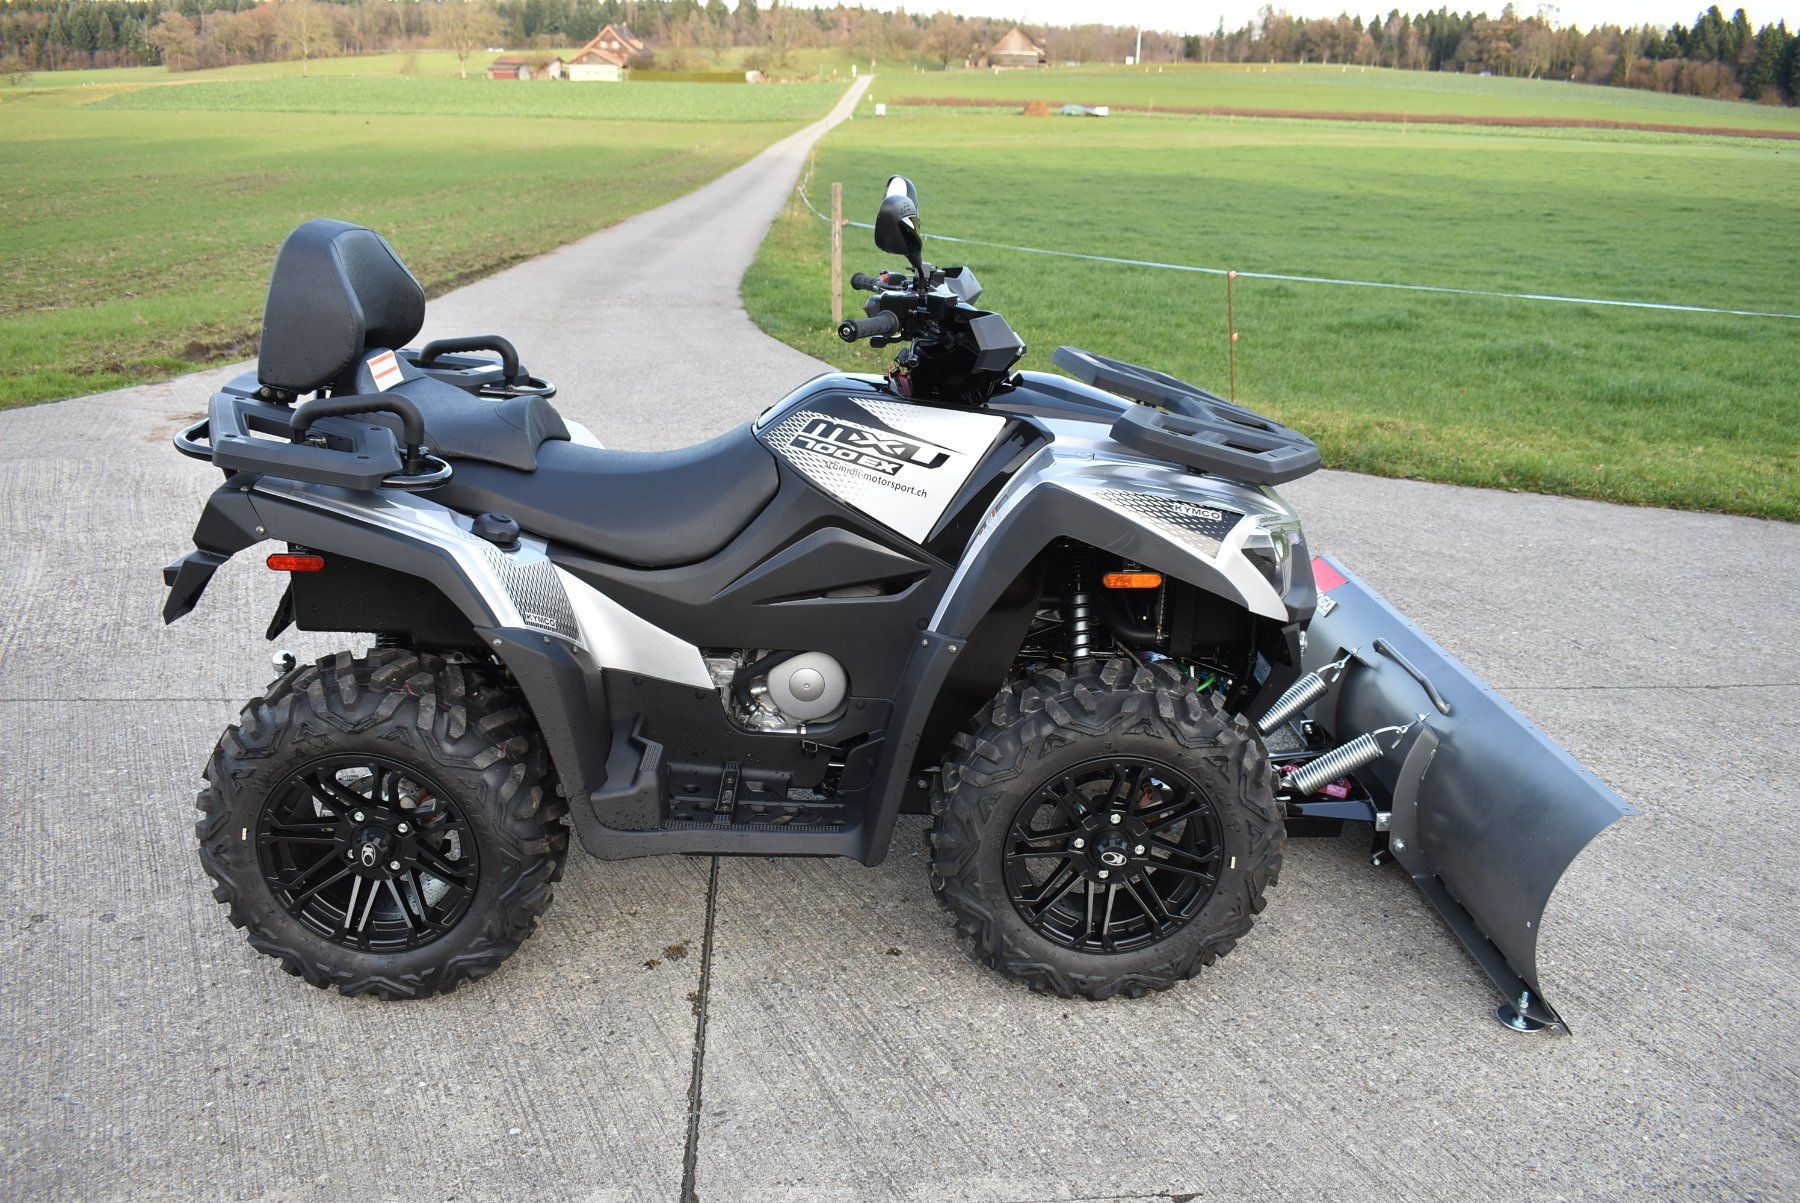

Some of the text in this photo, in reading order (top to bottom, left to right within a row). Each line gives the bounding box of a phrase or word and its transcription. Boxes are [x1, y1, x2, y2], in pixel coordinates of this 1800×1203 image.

[800, 418, 951, 469] MXU
[1174, 504, 1220, 519] KYMCO
[525, 613, 555, 627] KYMCO
